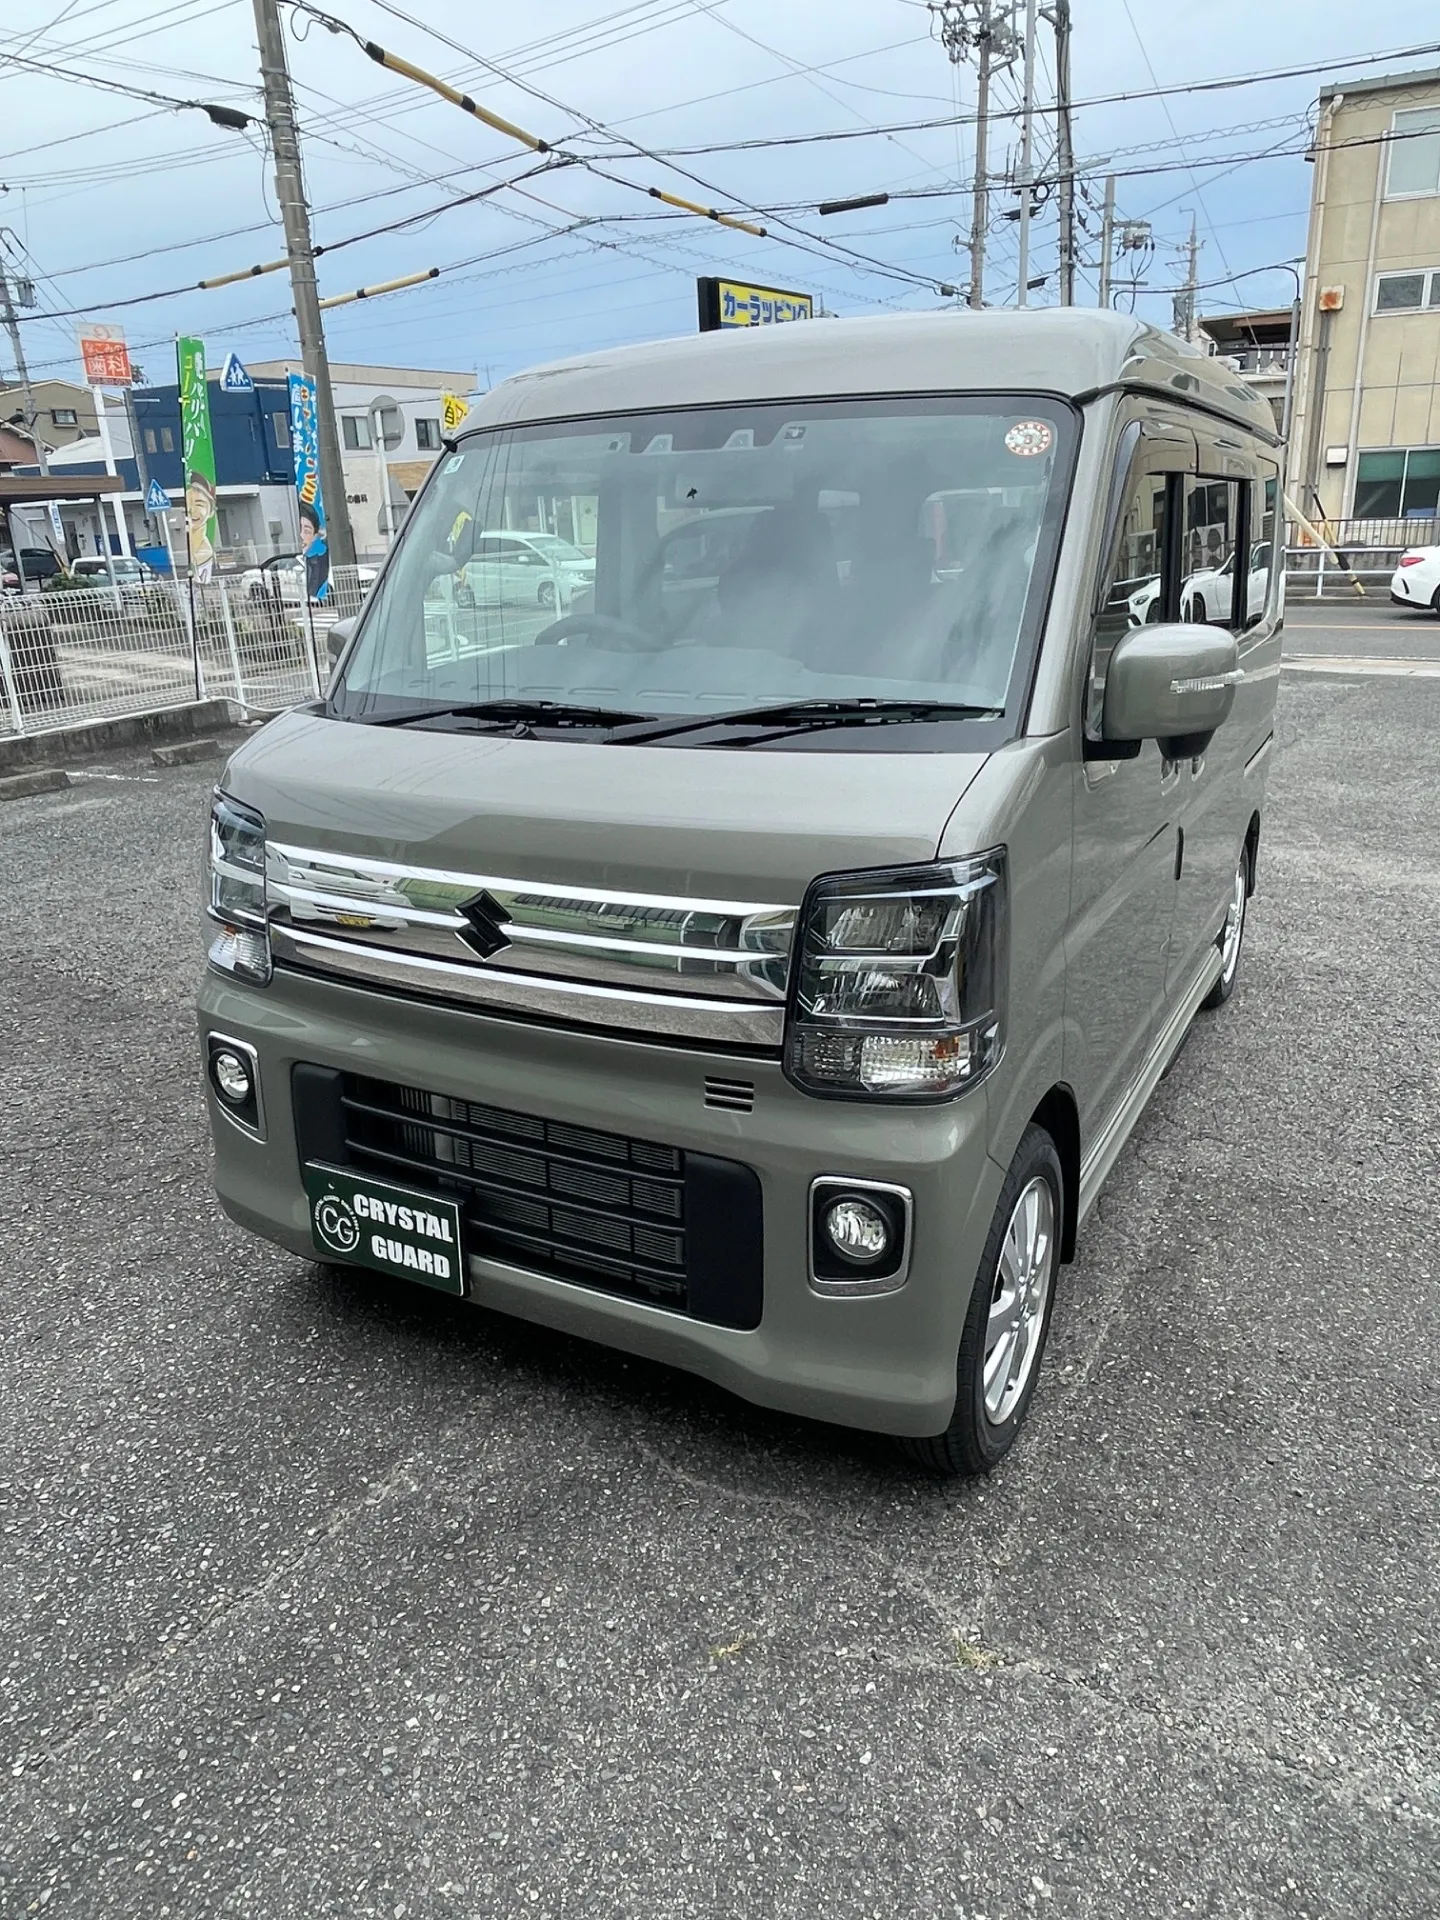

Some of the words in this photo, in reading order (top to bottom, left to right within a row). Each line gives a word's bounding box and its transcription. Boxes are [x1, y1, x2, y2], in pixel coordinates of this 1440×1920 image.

[722, 290, 809, 324] カーラッピング
[86, 355, 127, 377] 歯科
[353, 1193, 454, 1243] CRYSTAL
[371, 1235, 451, 1279] GUARD
